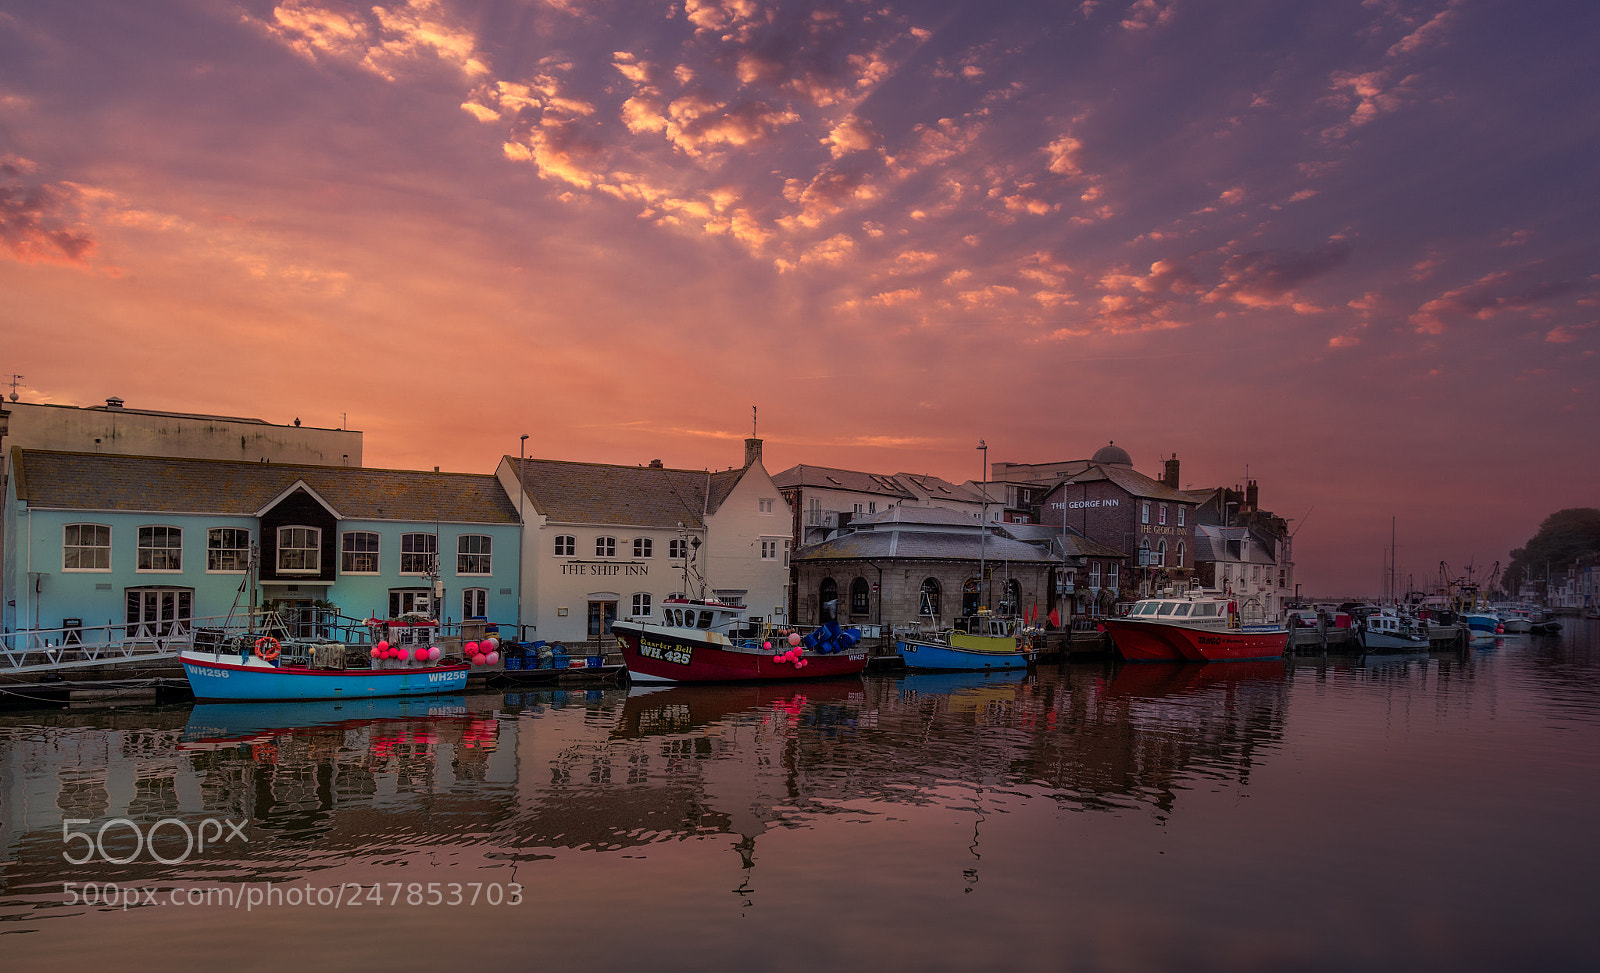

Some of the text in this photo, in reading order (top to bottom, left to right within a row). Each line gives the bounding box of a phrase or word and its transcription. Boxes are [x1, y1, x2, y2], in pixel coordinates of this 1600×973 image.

[1069, 500, 1101, 509] GEORGE
[1102, 499, 1119, 507] INN
[1140, 525, 1188, 536] THE GEORGE INN
[560, 564, 649, 576] THE SHIP INN
[674, 643, 693, 654] Bell
[188, 665, 230, 678] WH256
[428, 670, 466, 682] WH256
